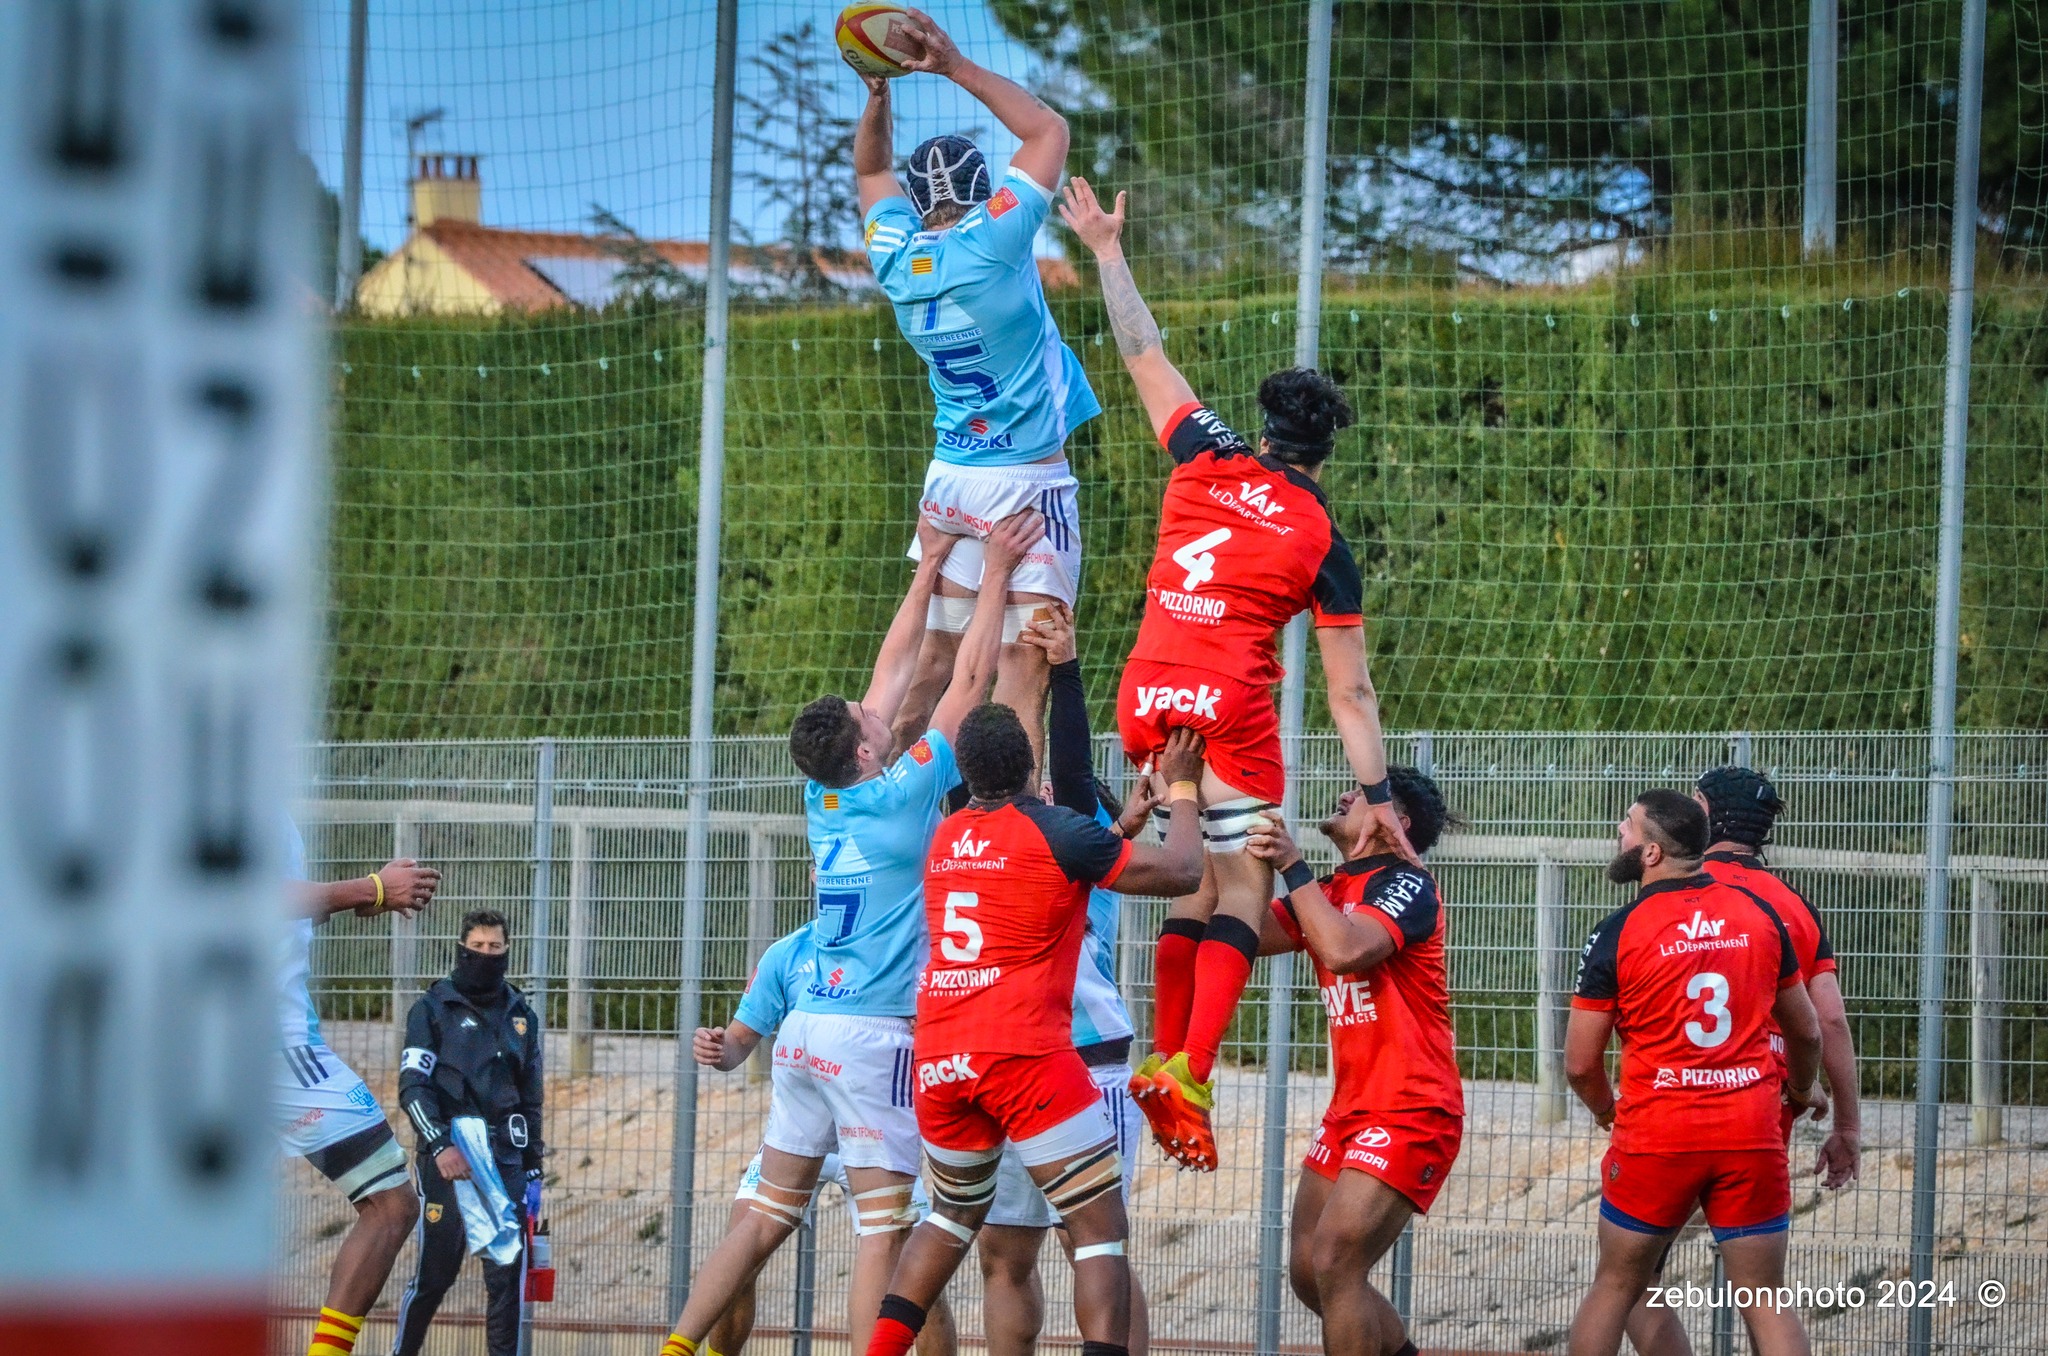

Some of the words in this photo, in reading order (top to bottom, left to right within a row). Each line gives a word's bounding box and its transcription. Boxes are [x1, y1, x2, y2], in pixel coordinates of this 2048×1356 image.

[931, 343, 999, 409] 5
[1172, 527, 1232, 591] 4
[1159, 590, 1226, 618] PIZZORNO
[819, 893, 860, 947] 7
[1380, 873, 1423, 919] TEAM
[941, 892, 983, 962] 5
[929, 967, 1000, 988] PIZZORNO
[1685, 972, 1732, 1048] 3
[1682, 1067, 1760, 1086] PIZZORNO
